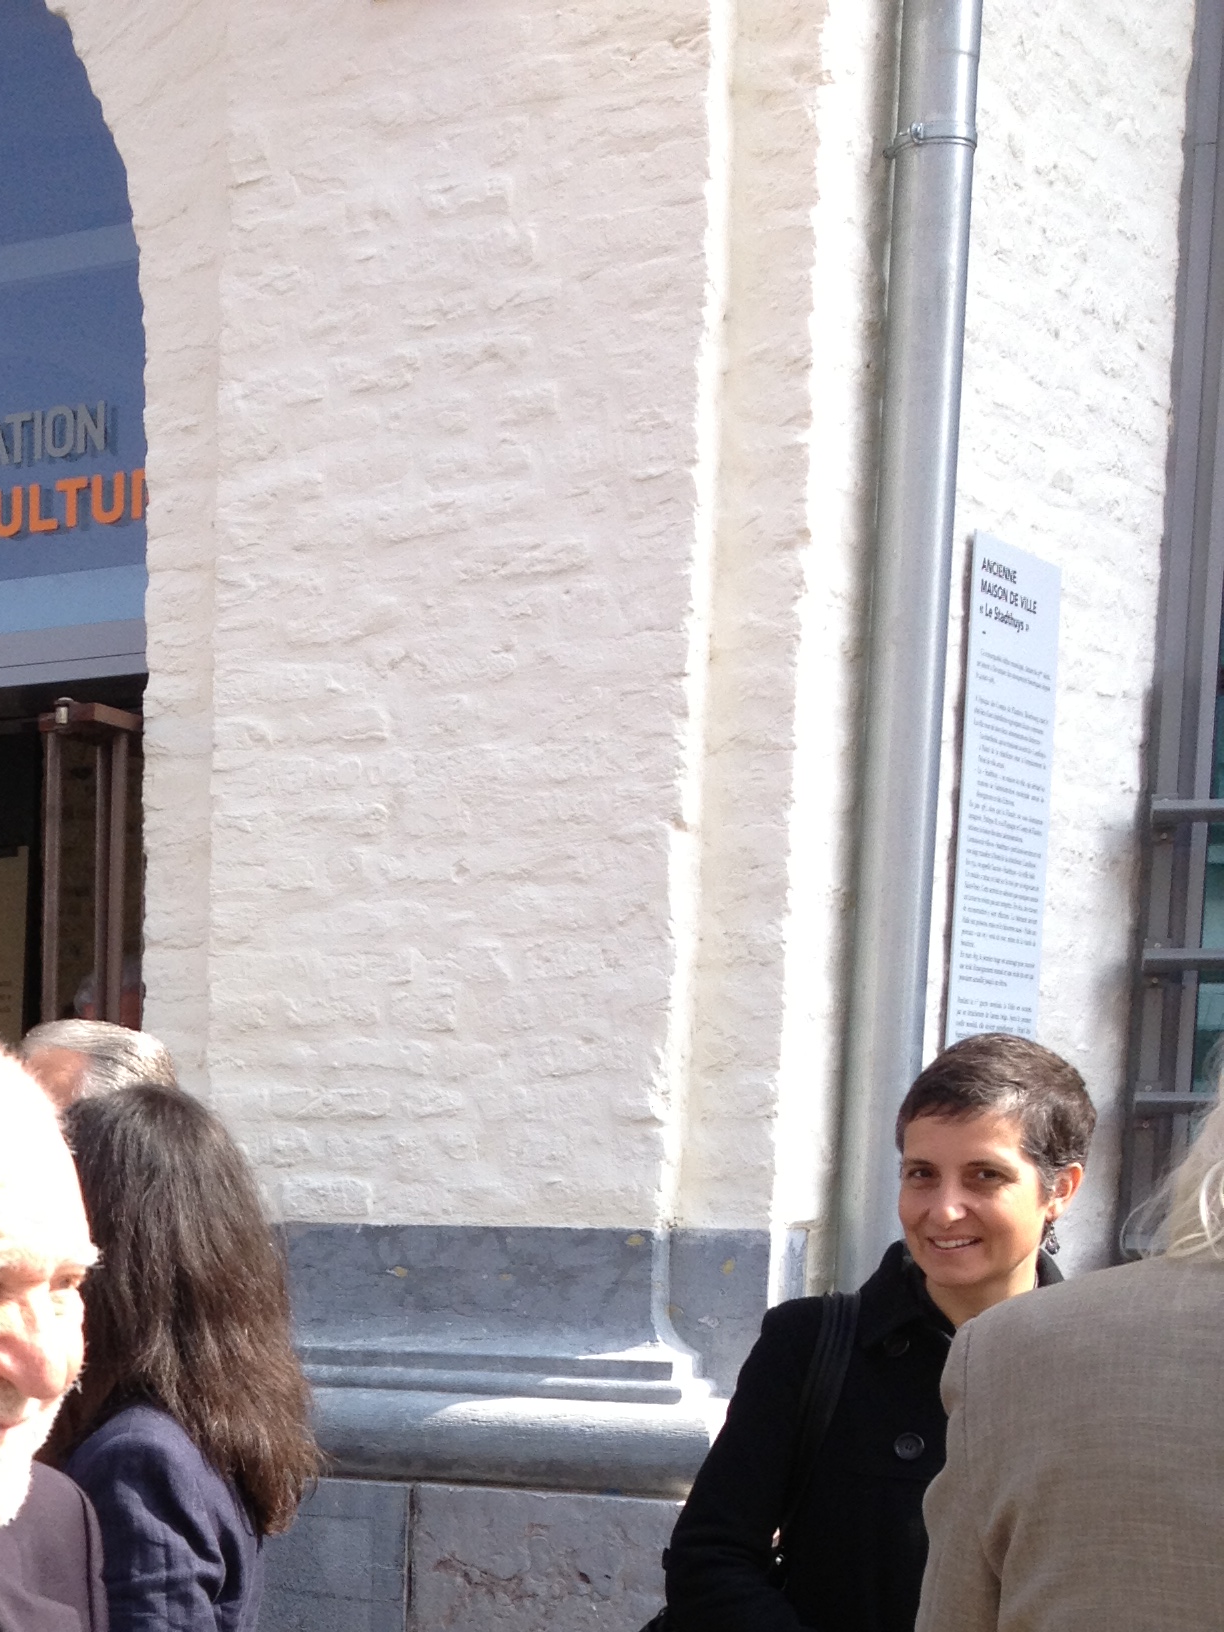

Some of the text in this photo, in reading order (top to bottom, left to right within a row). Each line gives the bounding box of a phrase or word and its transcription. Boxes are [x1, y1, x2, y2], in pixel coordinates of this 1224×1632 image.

[981, 557, 1017, 584] ANCIENNE
[981, 578, 1037, 614] MAISON DE VILLE
[985, 602, 993, 618] Le
